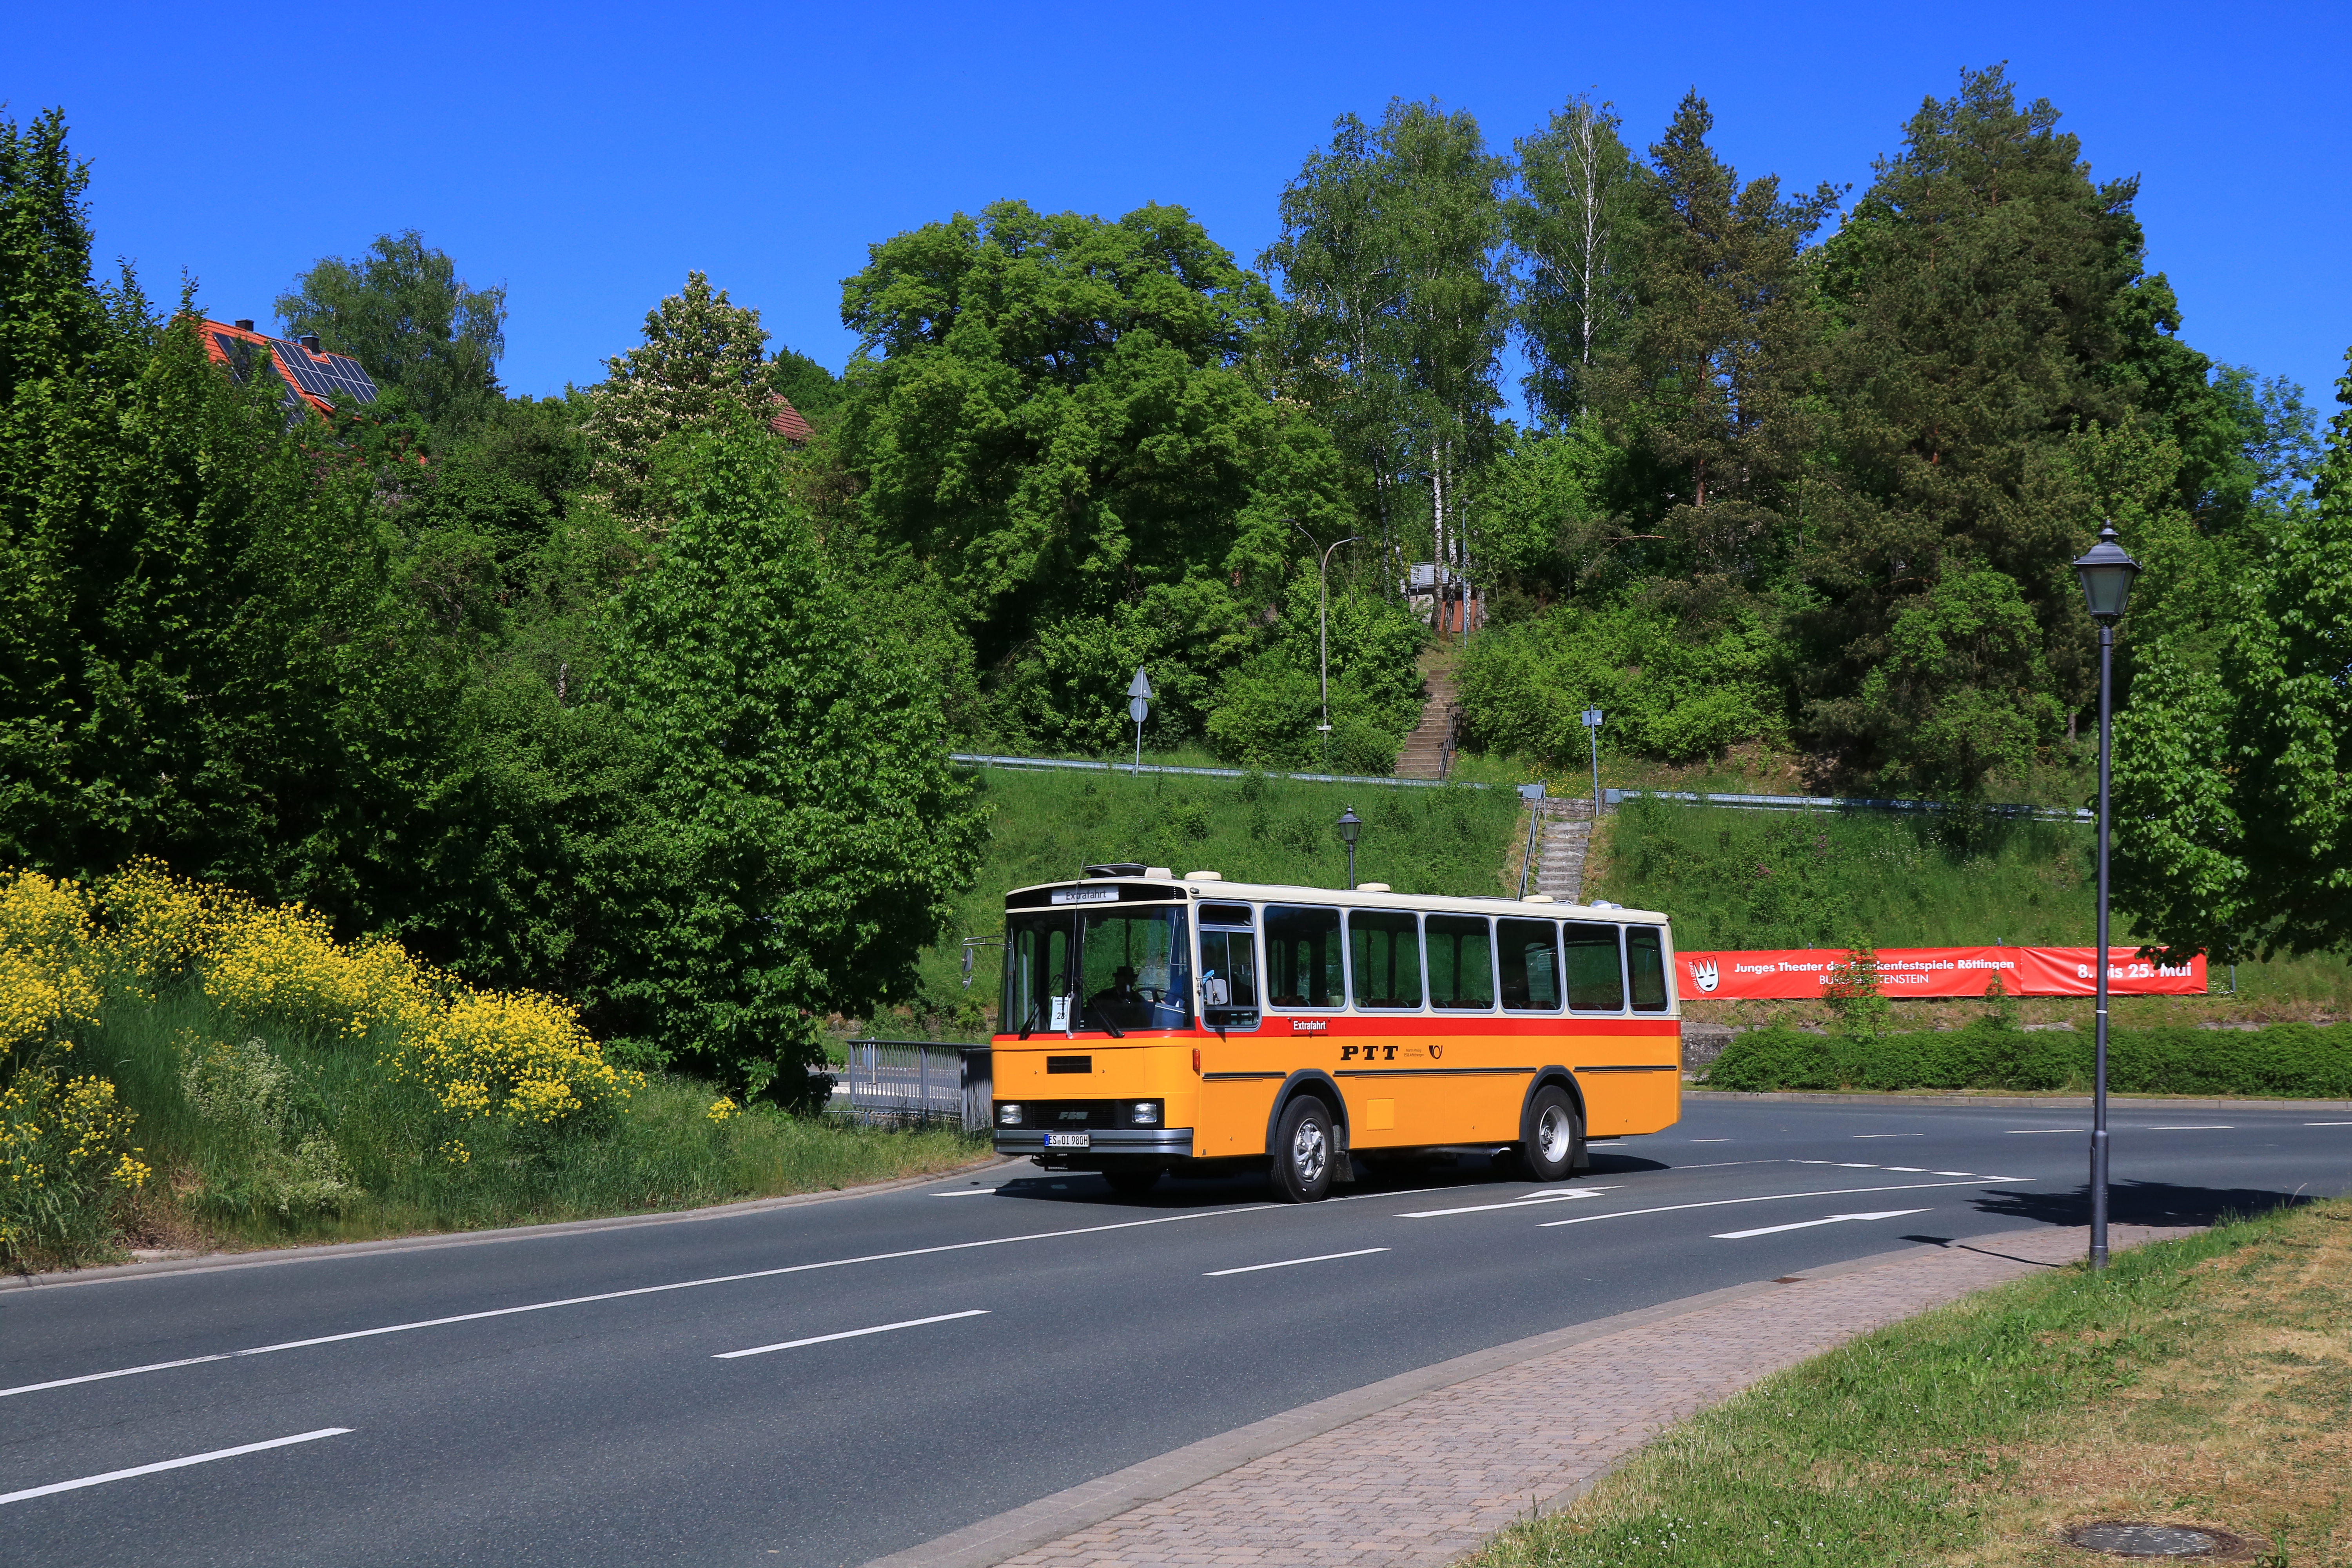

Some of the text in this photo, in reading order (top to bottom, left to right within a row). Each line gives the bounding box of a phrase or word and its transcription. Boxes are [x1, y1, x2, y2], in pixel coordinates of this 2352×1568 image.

[1066, 889, 1106, 900] Extrafahrt
[1734, 963, 1775, 975] Junges
[1778, 962, 1823, 972] Theater
[1850, 960, 1954, 972] Fkenfestspiele
[1957, 959, 2014, 970] Röttingen
[2078, 964, 2093, 978] 8.
[2107, 964, 2123, 978] is
[2128, 963, 2154, 978] 25.
[1692, 978, 1705, 995] THEATER
[1293, 1020, 1326, 1030] Extrafahrt
[1340, 1045, 1399, 1061] PTT
[1049, 1135, 1057, 1145] ES
[1071, 1136, 1088, 1145] 980H
